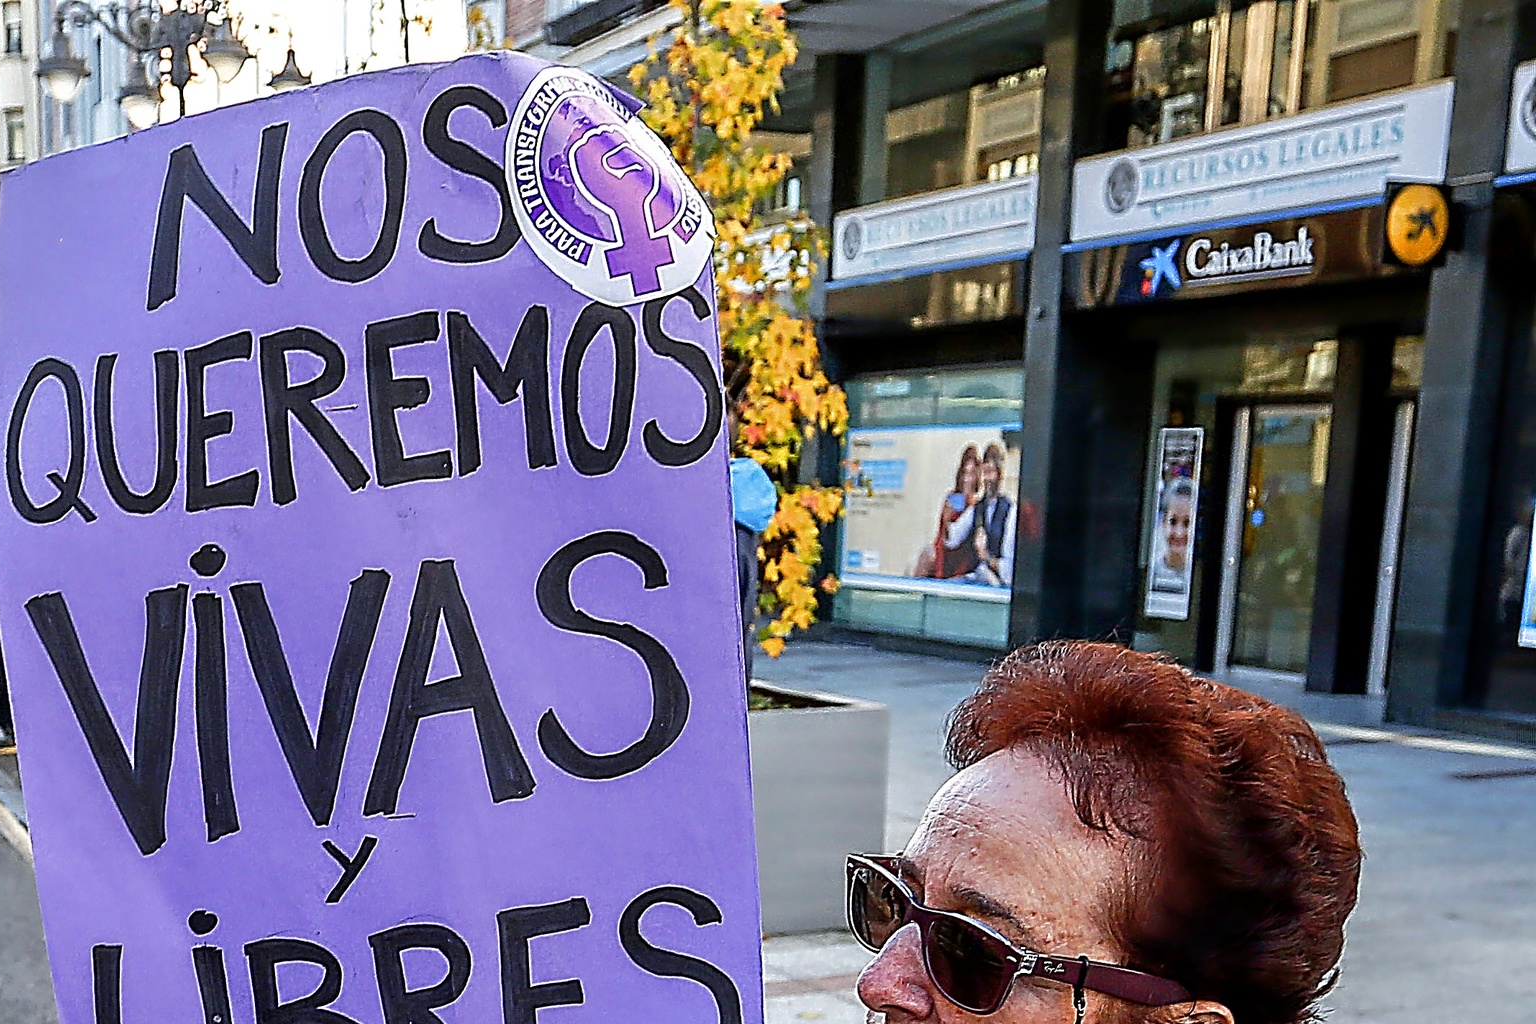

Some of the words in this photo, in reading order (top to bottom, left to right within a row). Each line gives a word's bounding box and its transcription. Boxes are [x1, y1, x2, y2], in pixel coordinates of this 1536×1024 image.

[1278, 114, 1404, 169] LEGALES
[147, 85, 520, 311] NOS
[535, 209, 586, 262] PARA
[1184, 226, 1315, 280] CaixaBank
[5, 286, 722, 523] QUEREMOS
